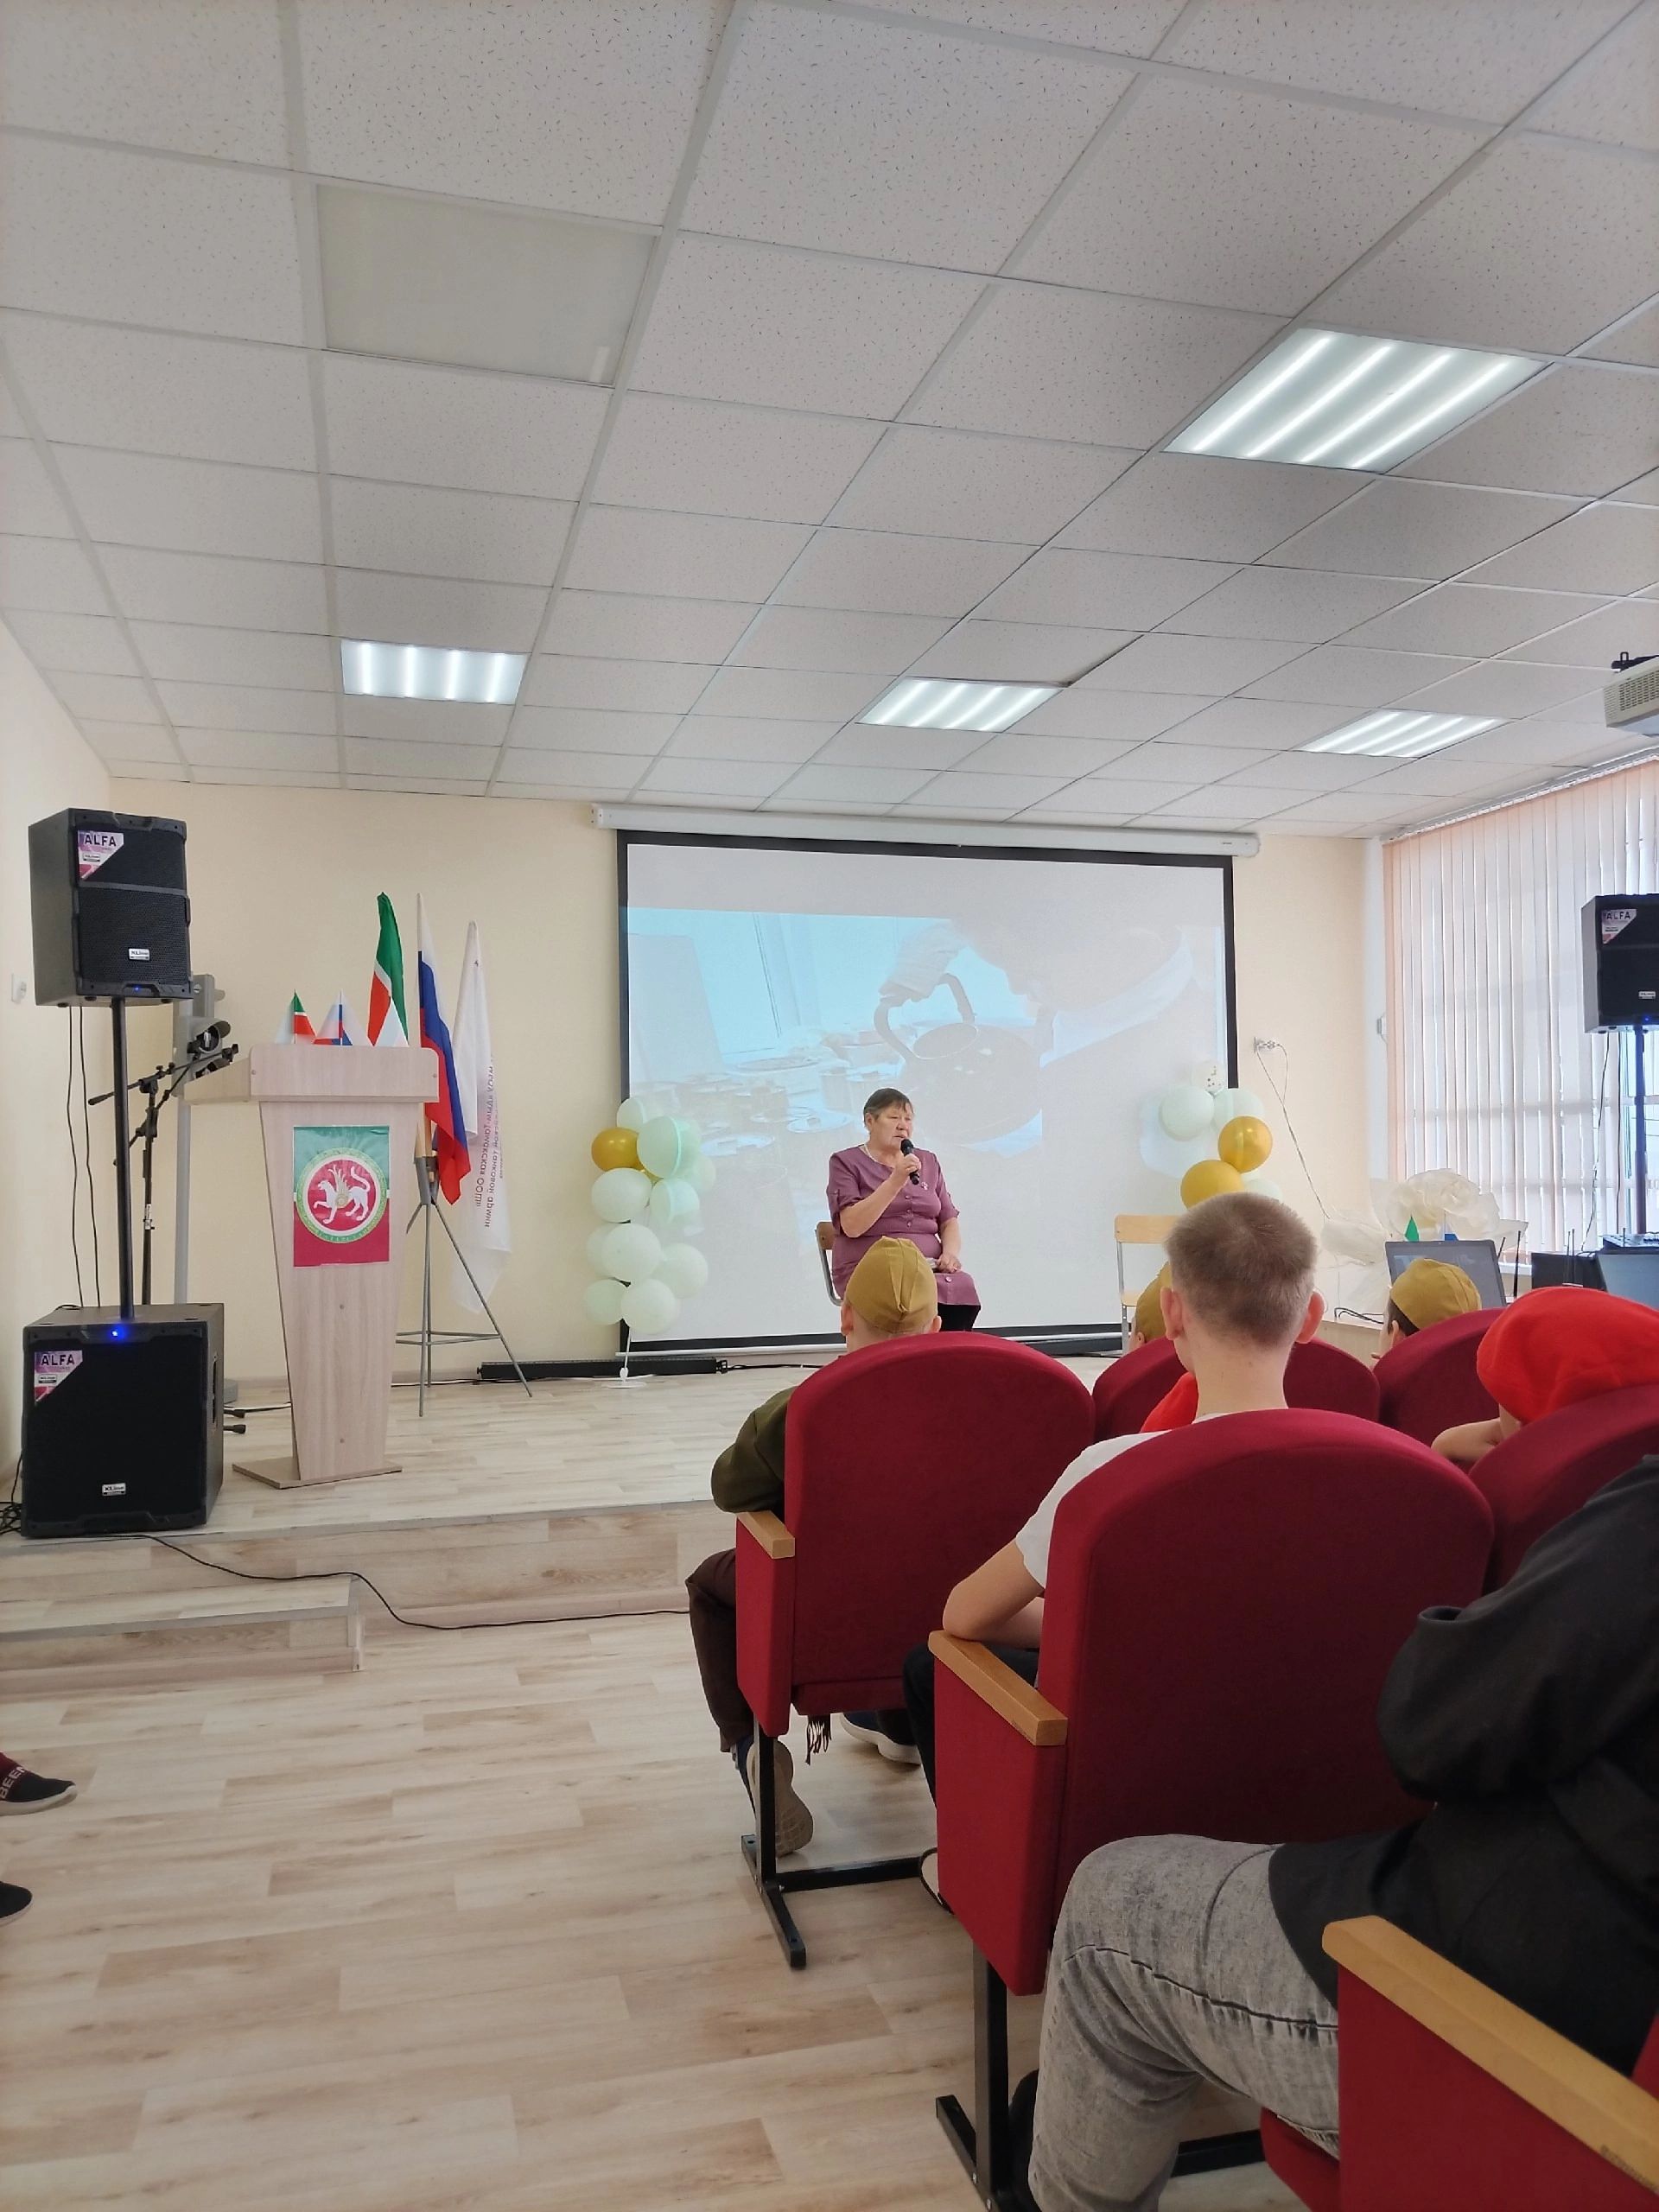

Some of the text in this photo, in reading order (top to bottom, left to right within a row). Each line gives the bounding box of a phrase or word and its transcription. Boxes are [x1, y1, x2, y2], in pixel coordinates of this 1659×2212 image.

[85, 834, 117, 847] ALFA
[1606, 911, 1630, 920] ALFA
[41, 1354, 75, 1366] ALFA
